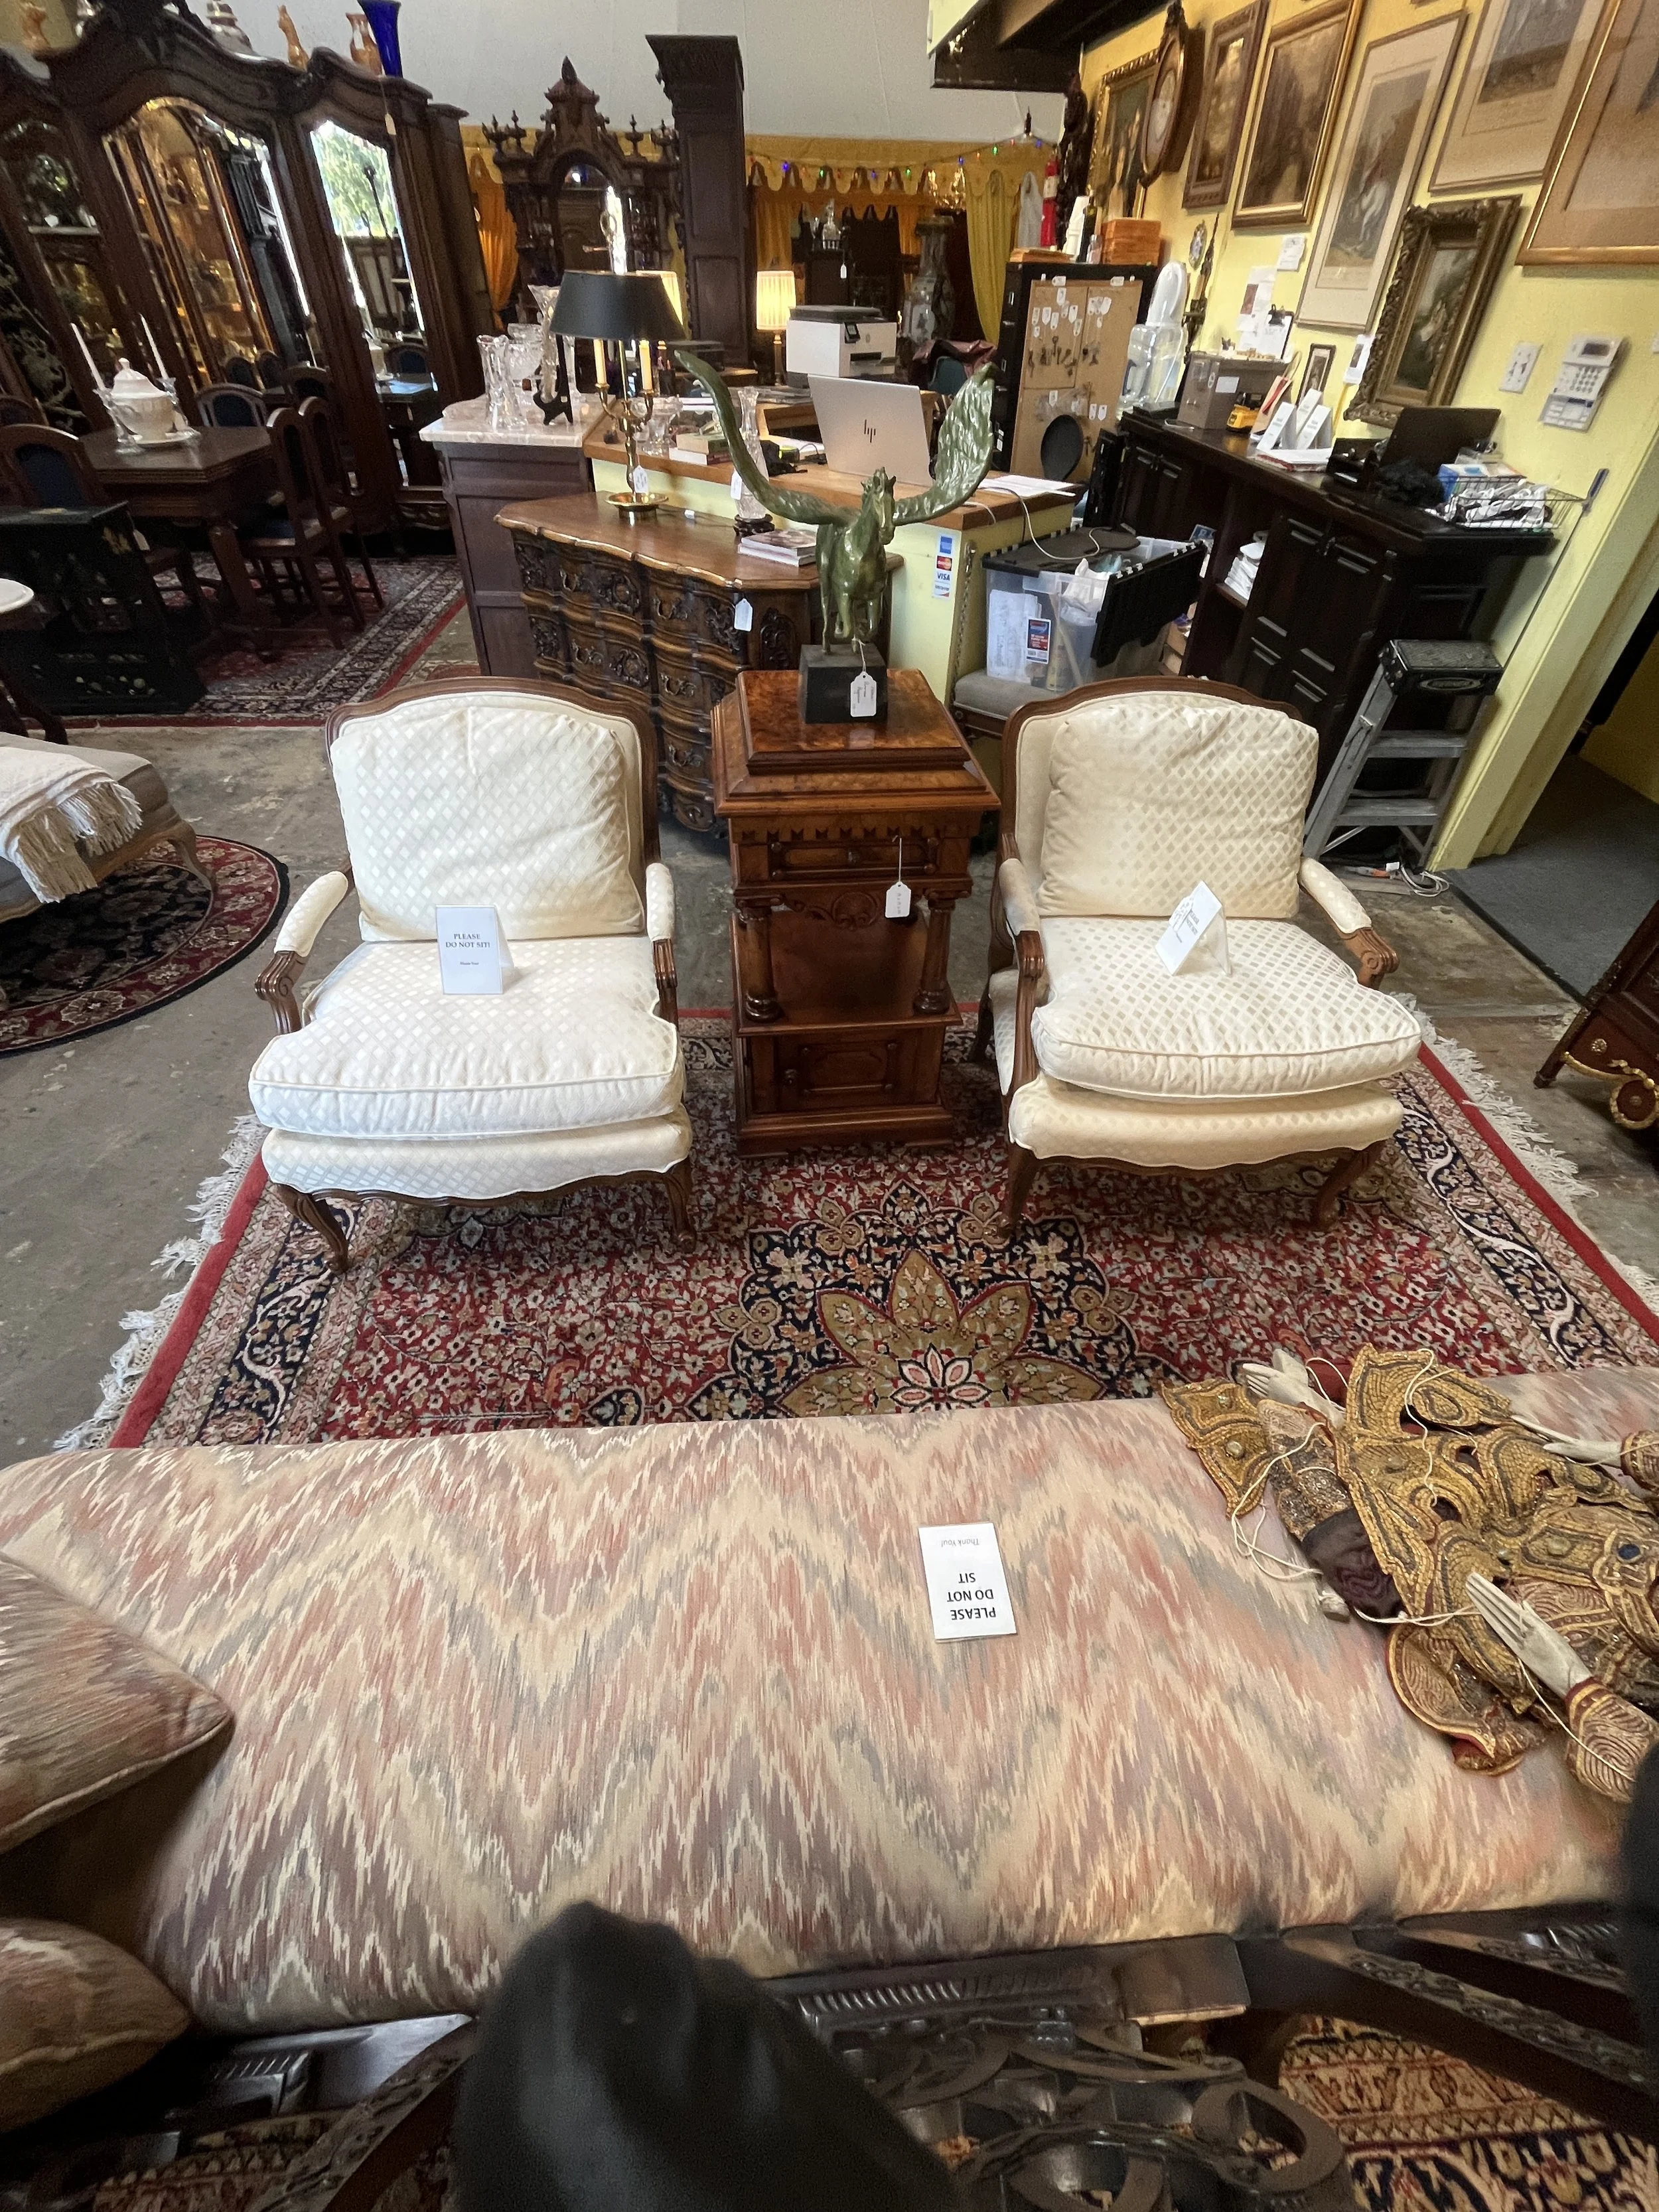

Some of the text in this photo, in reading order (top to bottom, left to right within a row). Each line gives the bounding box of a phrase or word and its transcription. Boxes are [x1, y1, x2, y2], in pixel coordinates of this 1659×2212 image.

[863, 419, 876, 443] hp
[941, 1538, 979, 1548] Thank You!
[958, 1572, 976, 1584] SIT
[946, 1589, 994, 1602] DO NOT
[950, 1607, 996, 1621] PLEASE
